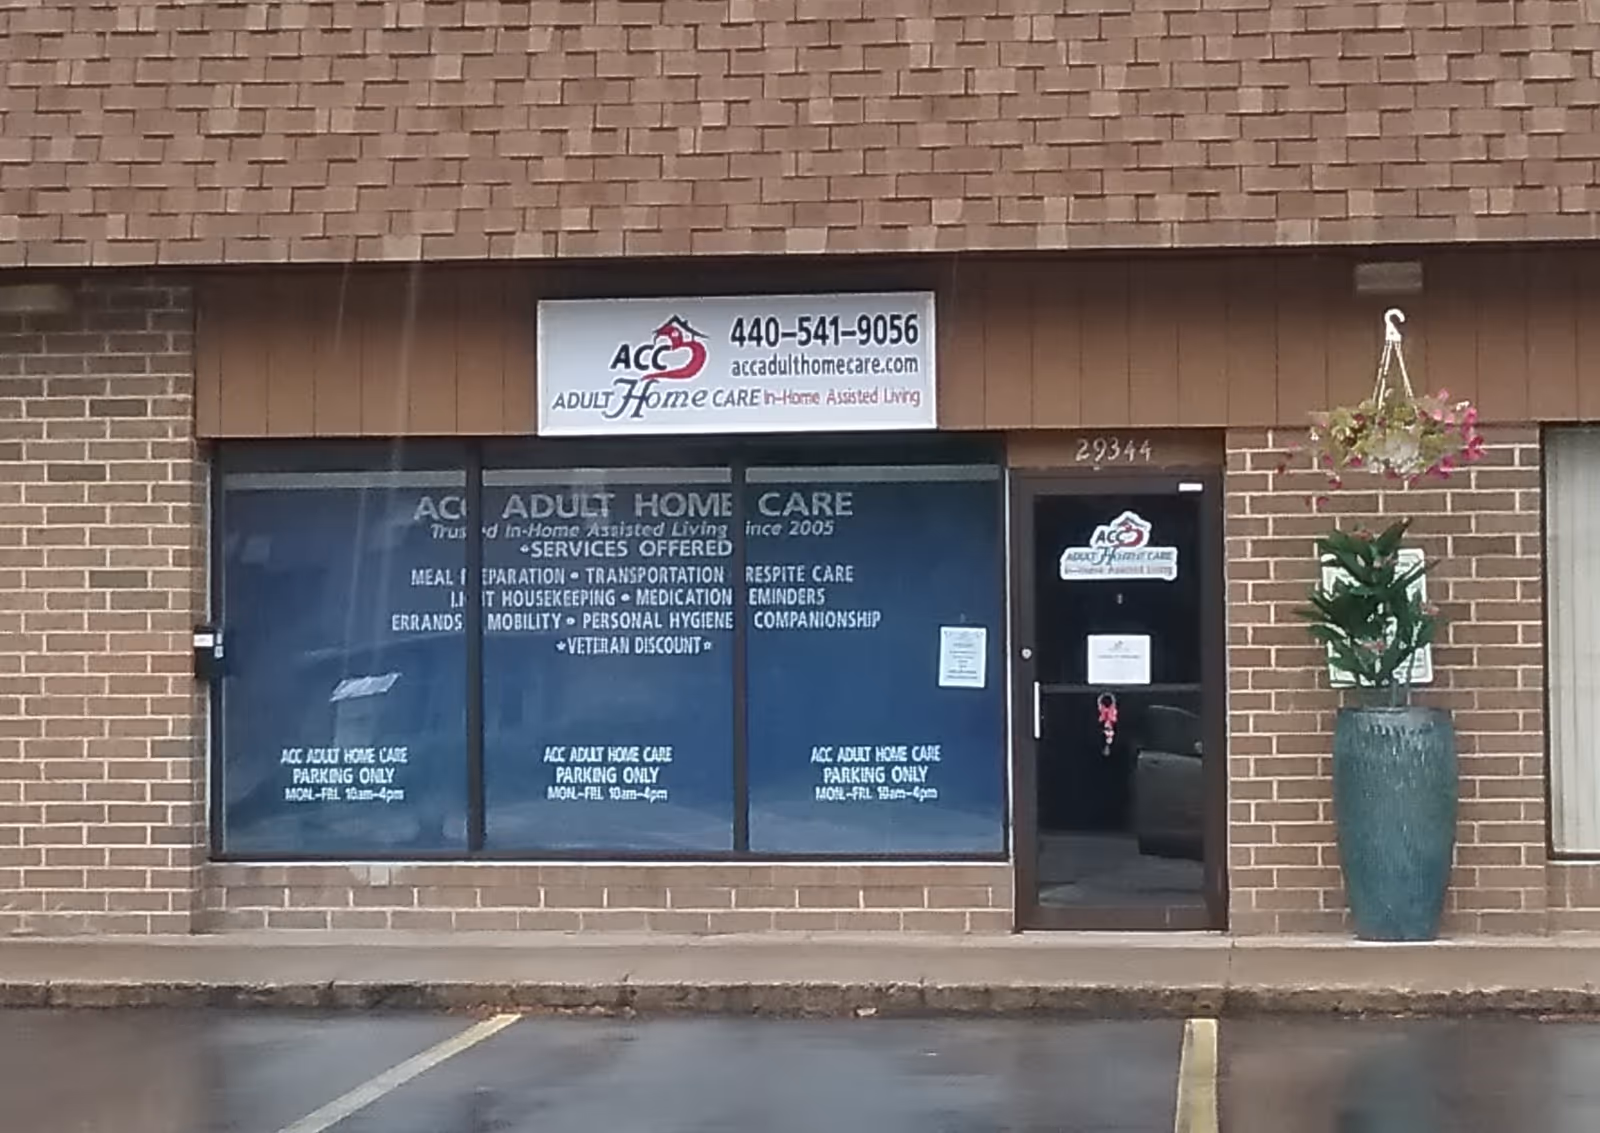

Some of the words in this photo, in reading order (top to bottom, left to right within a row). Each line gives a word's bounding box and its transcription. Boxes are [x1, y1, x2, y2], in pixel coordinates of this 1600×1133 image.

[730, 313, 919, 348] 440-541-9056
[610, 345, 671, 371] ACC
[731, 354, 919, 377] accadulthomecare.com
[552, 391, 614, 410] ADULT
[601, 377, 707, 419] Home
[712, 389, 761, 408] CARE
[764, 389, 820, 405] In-Home
[827, 387, 878, 404] Assisted
[884, 387, 921, 408] Living
[1075, 437, 1152, 462] 29344
[502, 493, 615, 519] ADULT
[635, 493, 732, 517] HOME
[758, 492, 854, 516] CARE
[505, 524, 580, 538] In-Home
[587, 522, 664, 538] Assisted
[671, 522, 729, 538] Living
[745, 520, 782, 536] ince
[789, 520, 834, 535] 2005
[1096, 530, 1125, 544] ACC
[531, 541, 628, 557] SERVICES
[639, 539, 733, 556] OFFERED
[411, 568, 453, 585] MEAL
[585, 566, 724, 584] TRANSPORTATION
[745, 566, 805, 582] RESPITE
[812, 565, 854, 582] CARE
[502, 589, 616, 607] HOUSEKEEPING
[636, 588, 732, 606] MEDICATION
[748, 587, 826, 605] EMINDERS
[391, 613, 463, 632] ERRANDS
[487, 612, 562, 631] MOBILITY
[583, 611, 663, 629] PERSONAL
[669, 611, 734, 629] HYGIENE
[753, 610, 881, 629] COMPANIONSHIP
[567, 637, 630, 655] VETERAN
[635, 636, 702, 655] DISCOUNT
[281, 747, 302, 763] ACC
[306, 747, 340, 763] ADULT
[344, 747, 376, 763] HOME
[379, 746, 408, 763] CARE
[544, 746, 566, 762] ACC
[569, 746, 605, 763] ADULT
[607, 746, 640, 762] HOME
[642, 746, 673, 762] CARE
[810, 746, 833, 763] ACC
[837, 746, 872, 762] ADULT
[875, 745, 908, 762] HOME
[911, 745, 941, 761] CARE
[293, 767, 354, 784] PARKING
[359, 767, 395, 784] ONLY
[556, 766, 617, 784] PARKING
[622, 766, 660, 784] ONLY
[823, 765, 886, 784] PARKING
[891, 764, 929, 783] ONLY
